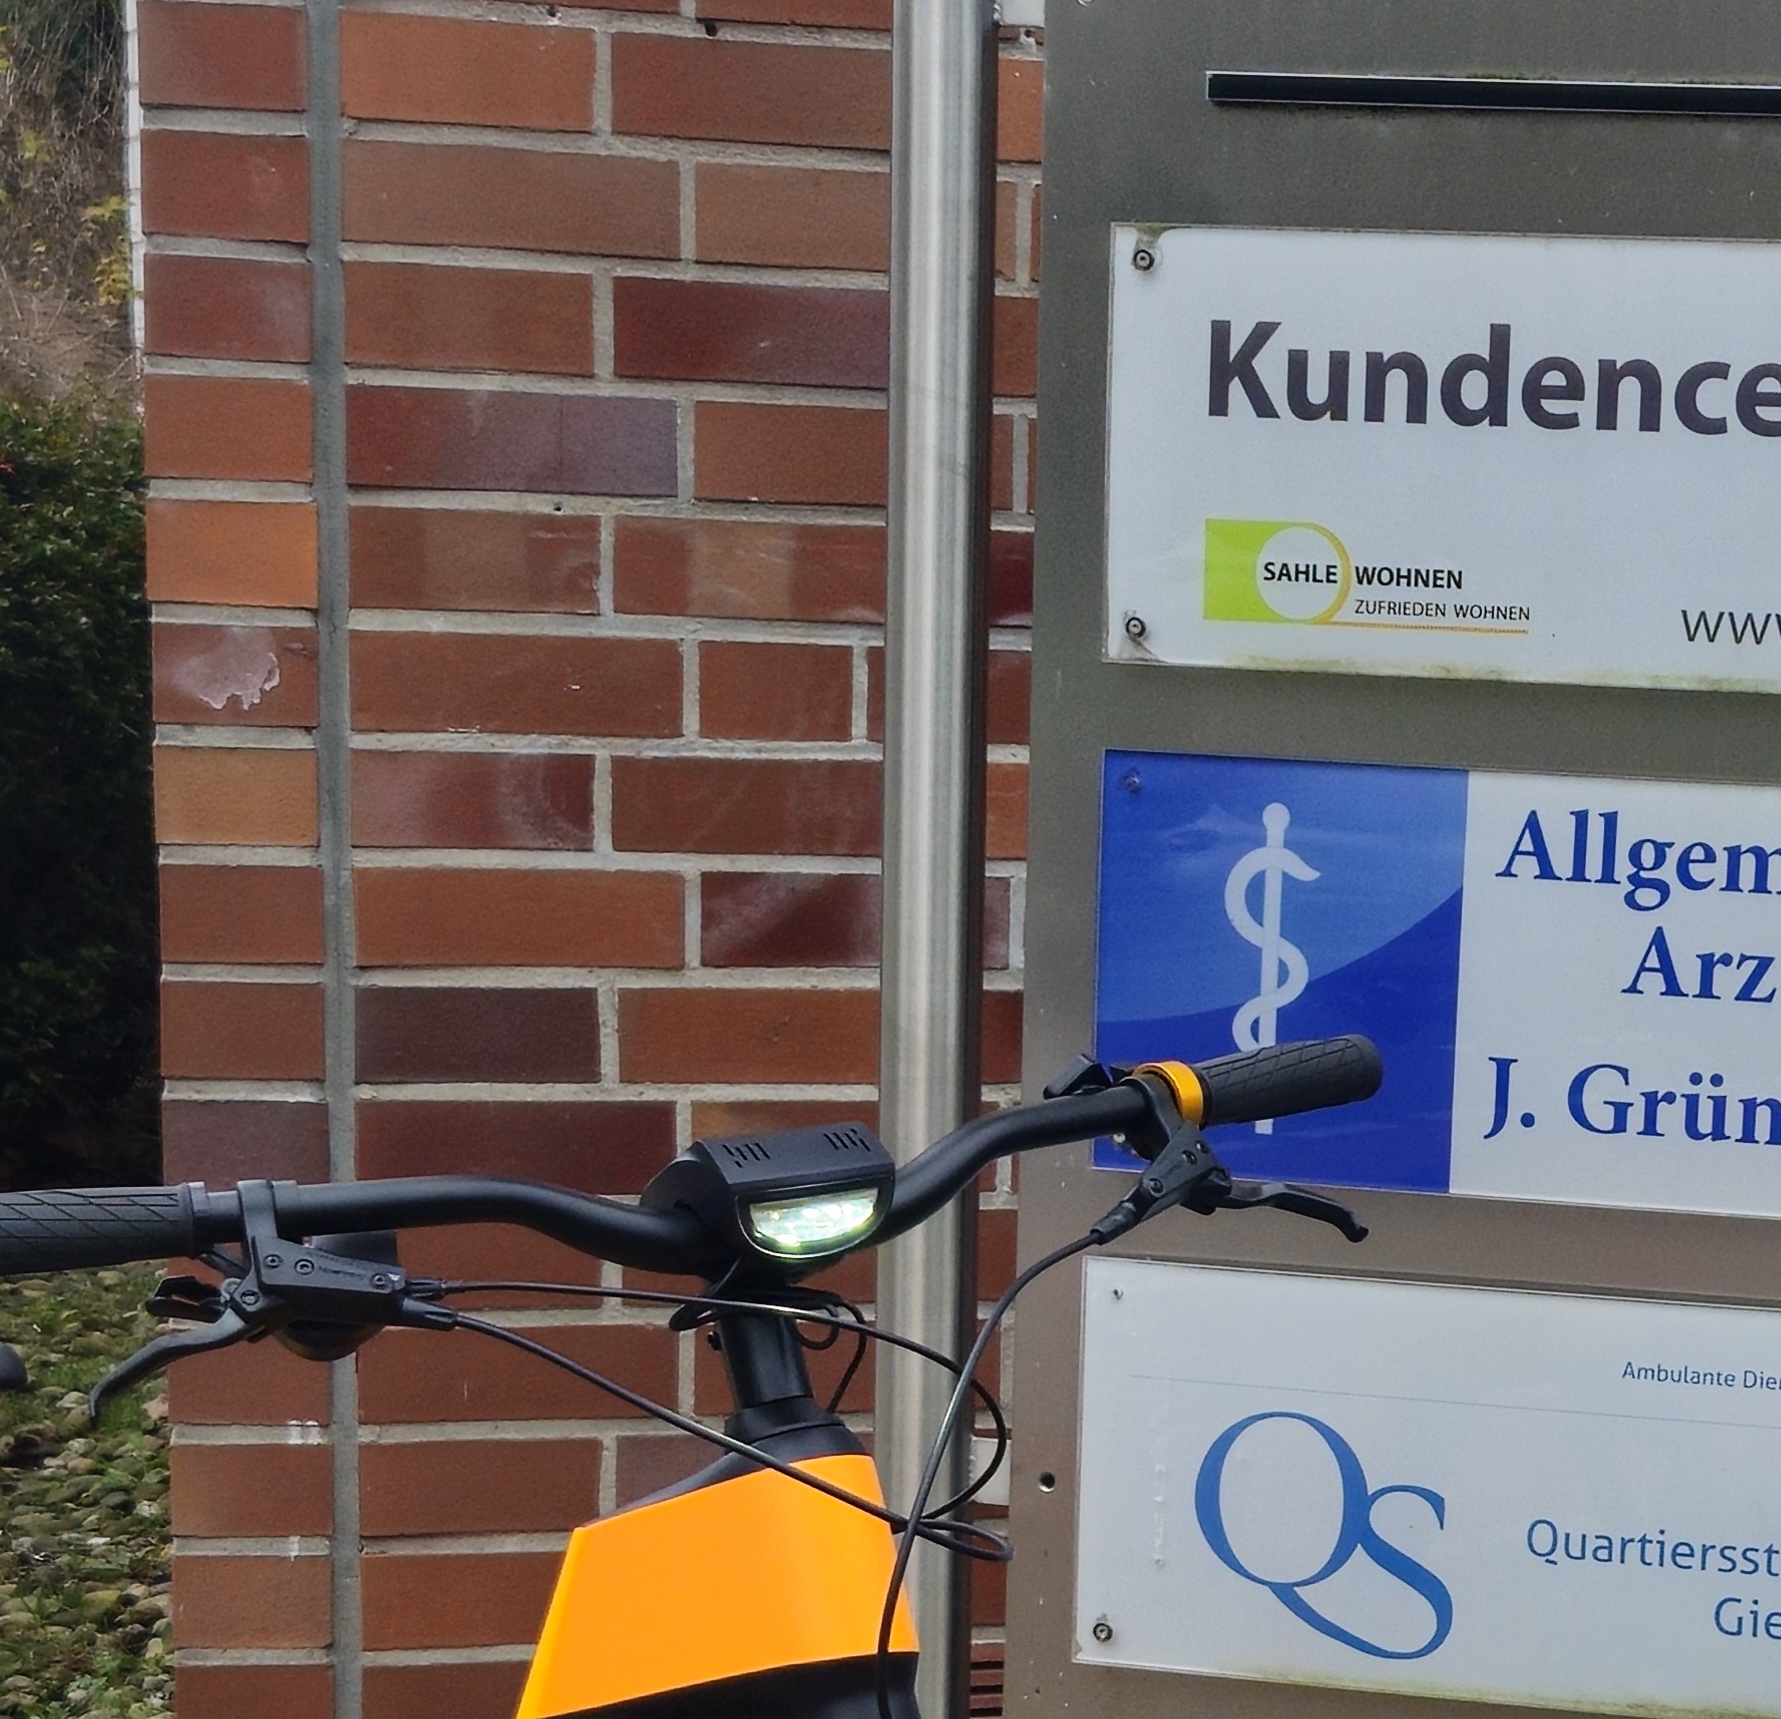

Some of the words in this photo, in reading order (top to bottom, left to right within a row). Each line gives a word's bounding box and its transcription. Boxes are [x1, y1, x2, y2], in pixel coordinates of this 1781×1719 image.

[1262, 560, 1339, 588] SAHLE
[1354, 564, 1464, 592] WOHNEN
[1354, 598, 1448, 620] ZUFRIEDEN
[1452, 602, 1531, 624] WOHNEN
[1483, 1056, 1536, 1140] J.
[1621, 1361, 1737, 1392] Ambulante
[1194, 1411, 1454, 1660] QS
